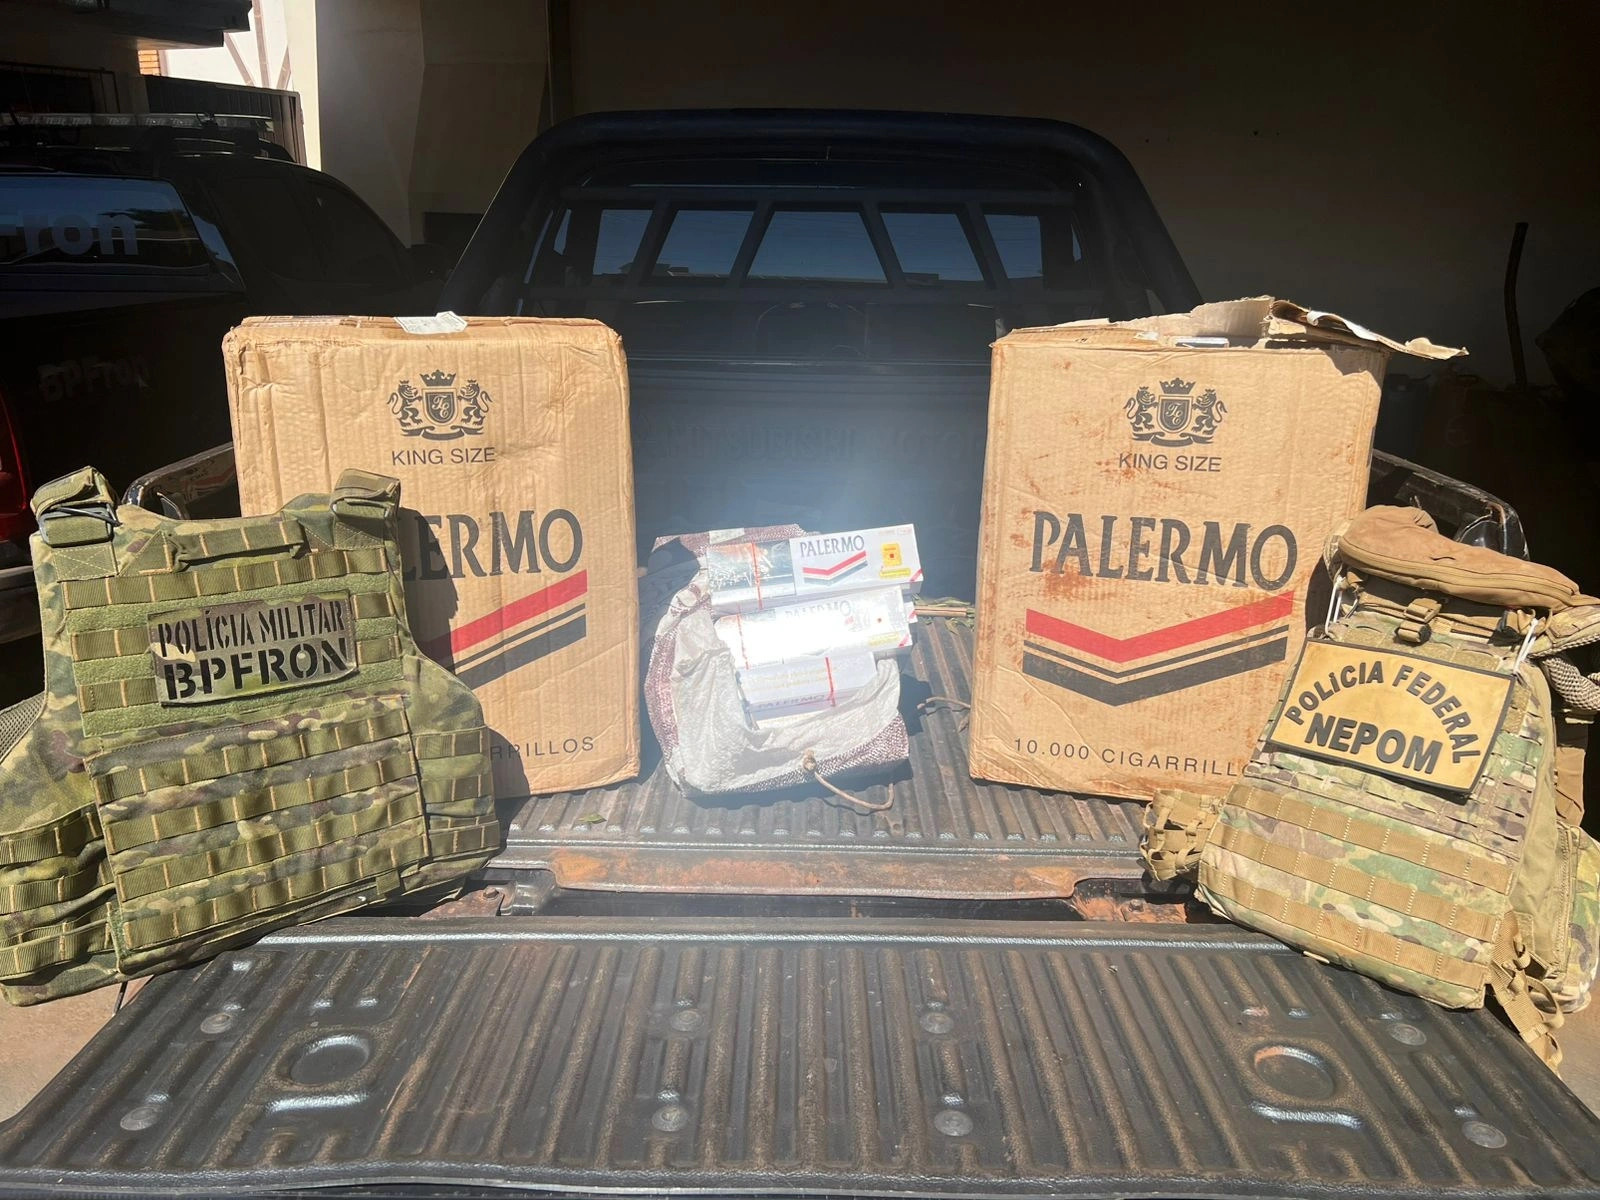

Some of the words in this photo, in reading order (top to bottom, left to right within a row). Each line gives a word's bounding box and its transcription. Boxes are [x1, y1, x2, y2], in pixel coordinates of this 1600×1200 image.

[0, 213, 139, 256] ron
[391, 448, 444, 466] KING
[450, 447, 496, 464] SIZE
[1119, 453, 1169, 470] KING
[1174, 455, 1222, 472] SIZE
[800, 534, 866, 558] PALERMO
[1029, 510, 1298, 591] PALERMO
[158, 610, 255, 658] POLÍCIA
[258, 600, 345, 643] MILITAR
[163, 637, 349, 700] BPFRON
[1392, 665, 1481, 764] FEDERAL
[1014, 738, 1090, 760] 10.000
[1101, 748, 1249, 778] CIGARRILL
[1304, 712, 1443, 775] NEPOM
